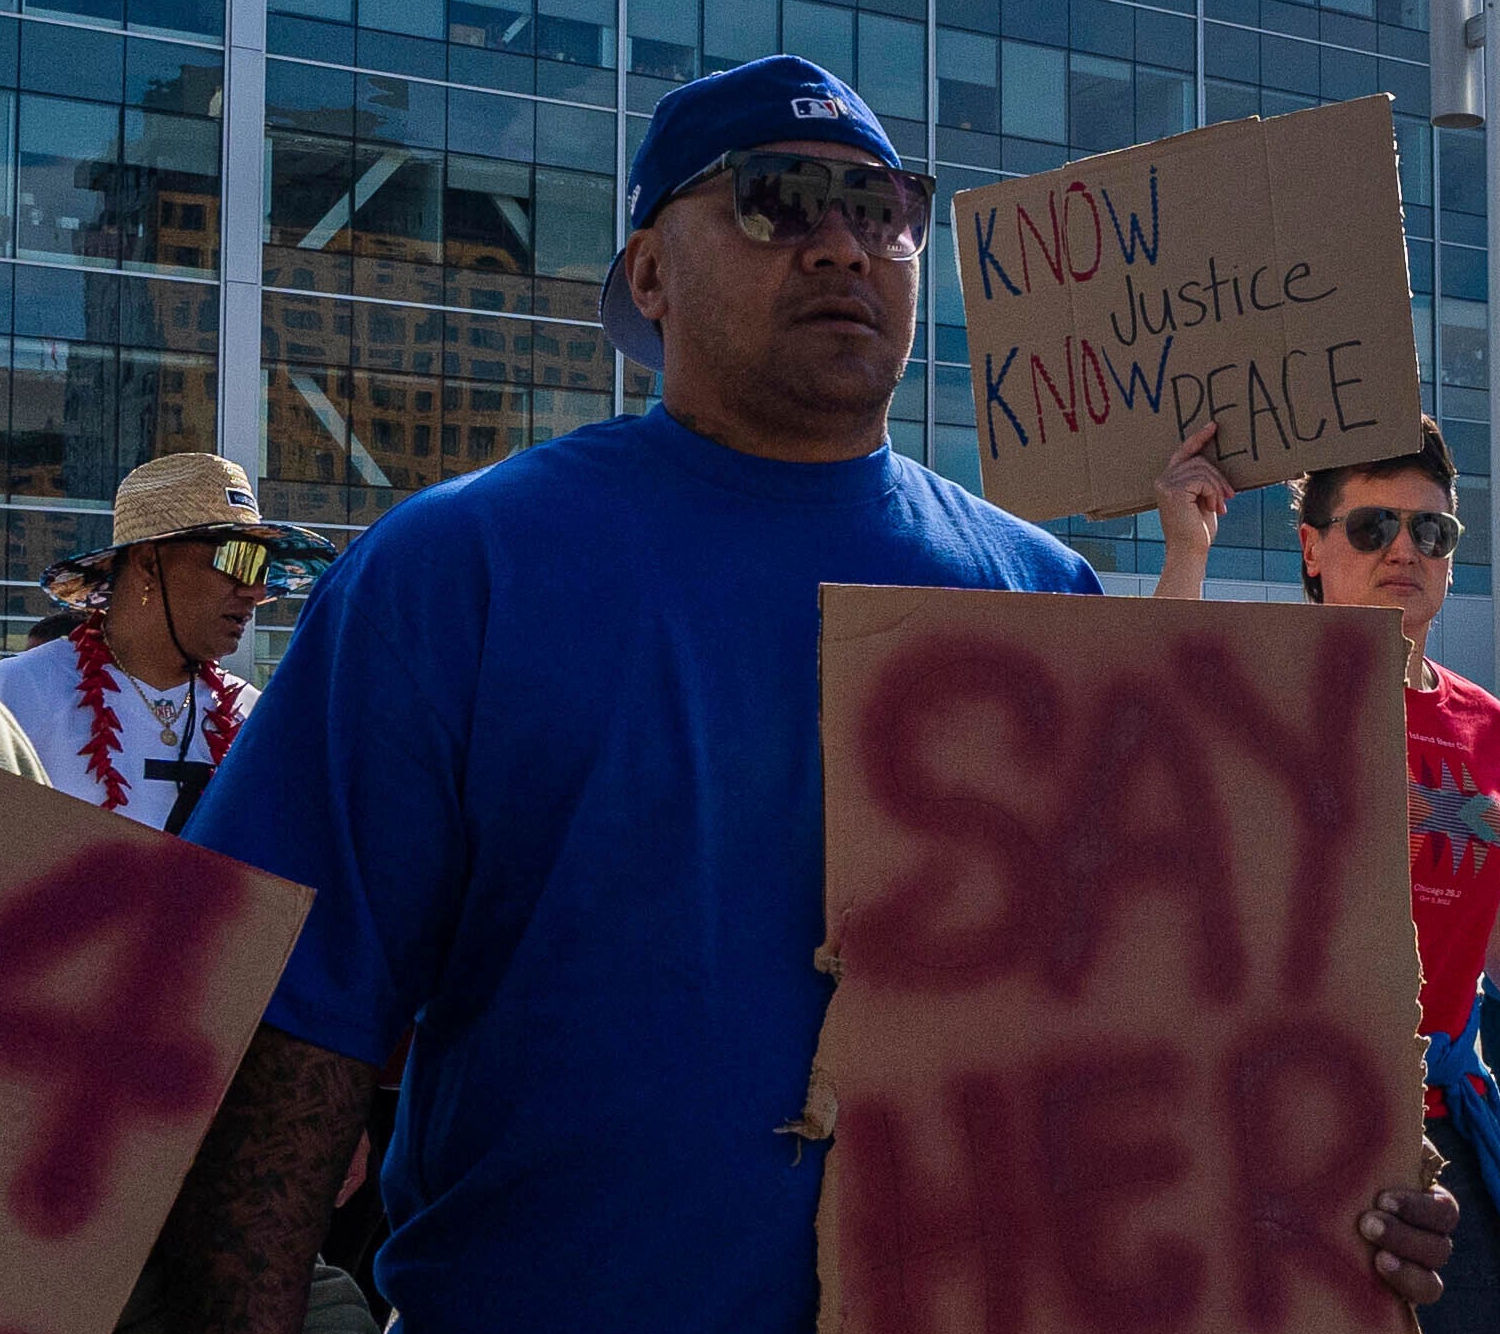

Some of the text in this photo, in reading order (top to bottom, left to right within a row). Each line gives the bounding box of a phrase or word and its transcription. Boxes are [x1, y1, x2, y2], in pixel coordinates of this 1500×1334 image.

[975, 166, 1160, 300] KNOW
[1110, 258, 1337, 346] Justice
[985, 335, 1376, 460] KNOW PEACE
[841, 622, 1380, 1005] SAY
[1413, 883, 1444, 897] Chicago
